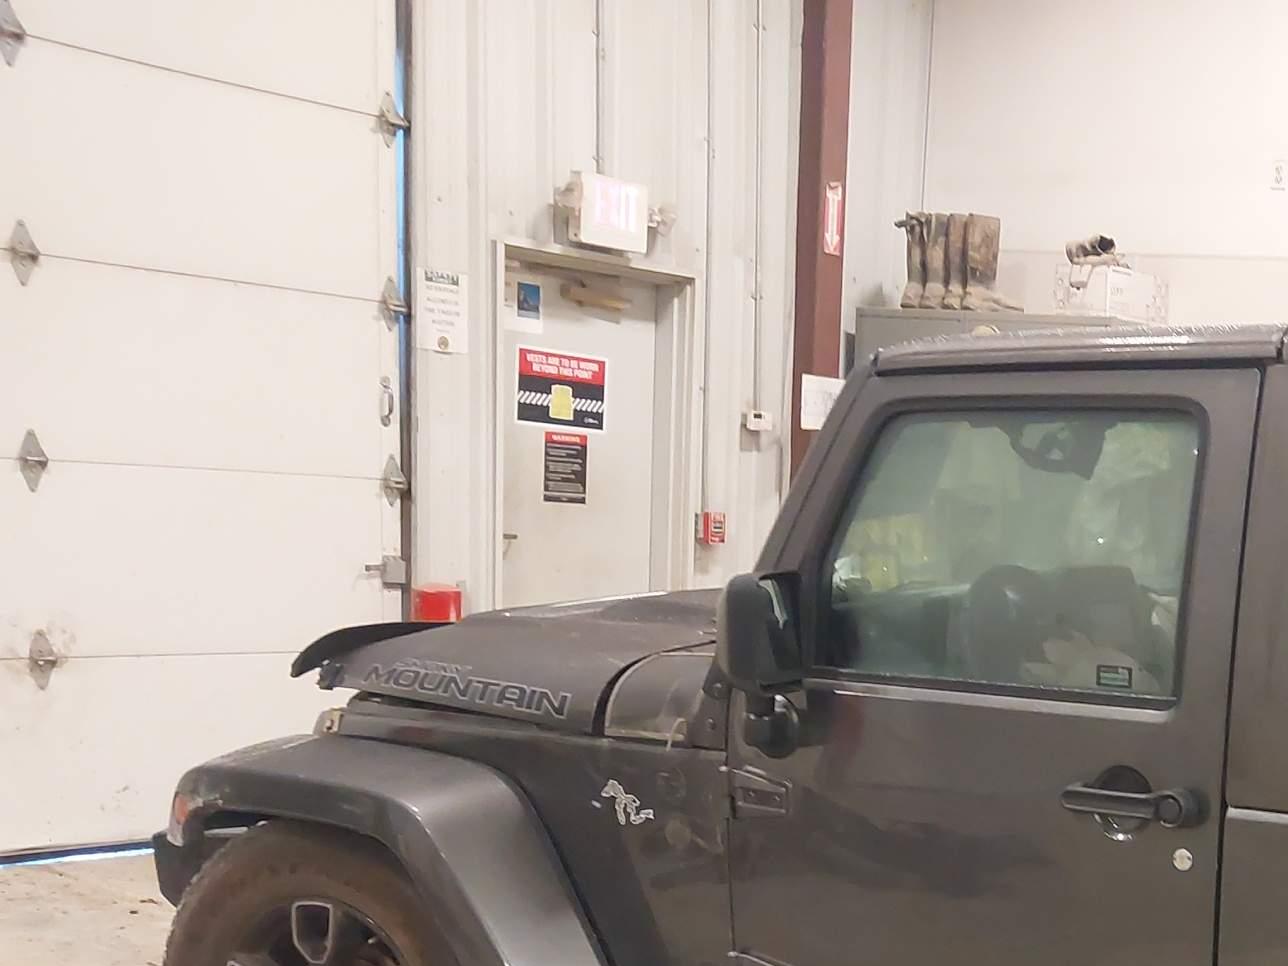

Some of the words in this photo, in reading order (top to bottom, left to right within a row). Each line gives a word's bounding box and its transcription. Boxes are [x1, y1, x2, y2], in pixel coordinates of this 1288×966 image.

[560, 358, 569, 367] TO
[573, 369, 593, 379] POINT
[361, 663, 573, 719] MOUNTAIN
